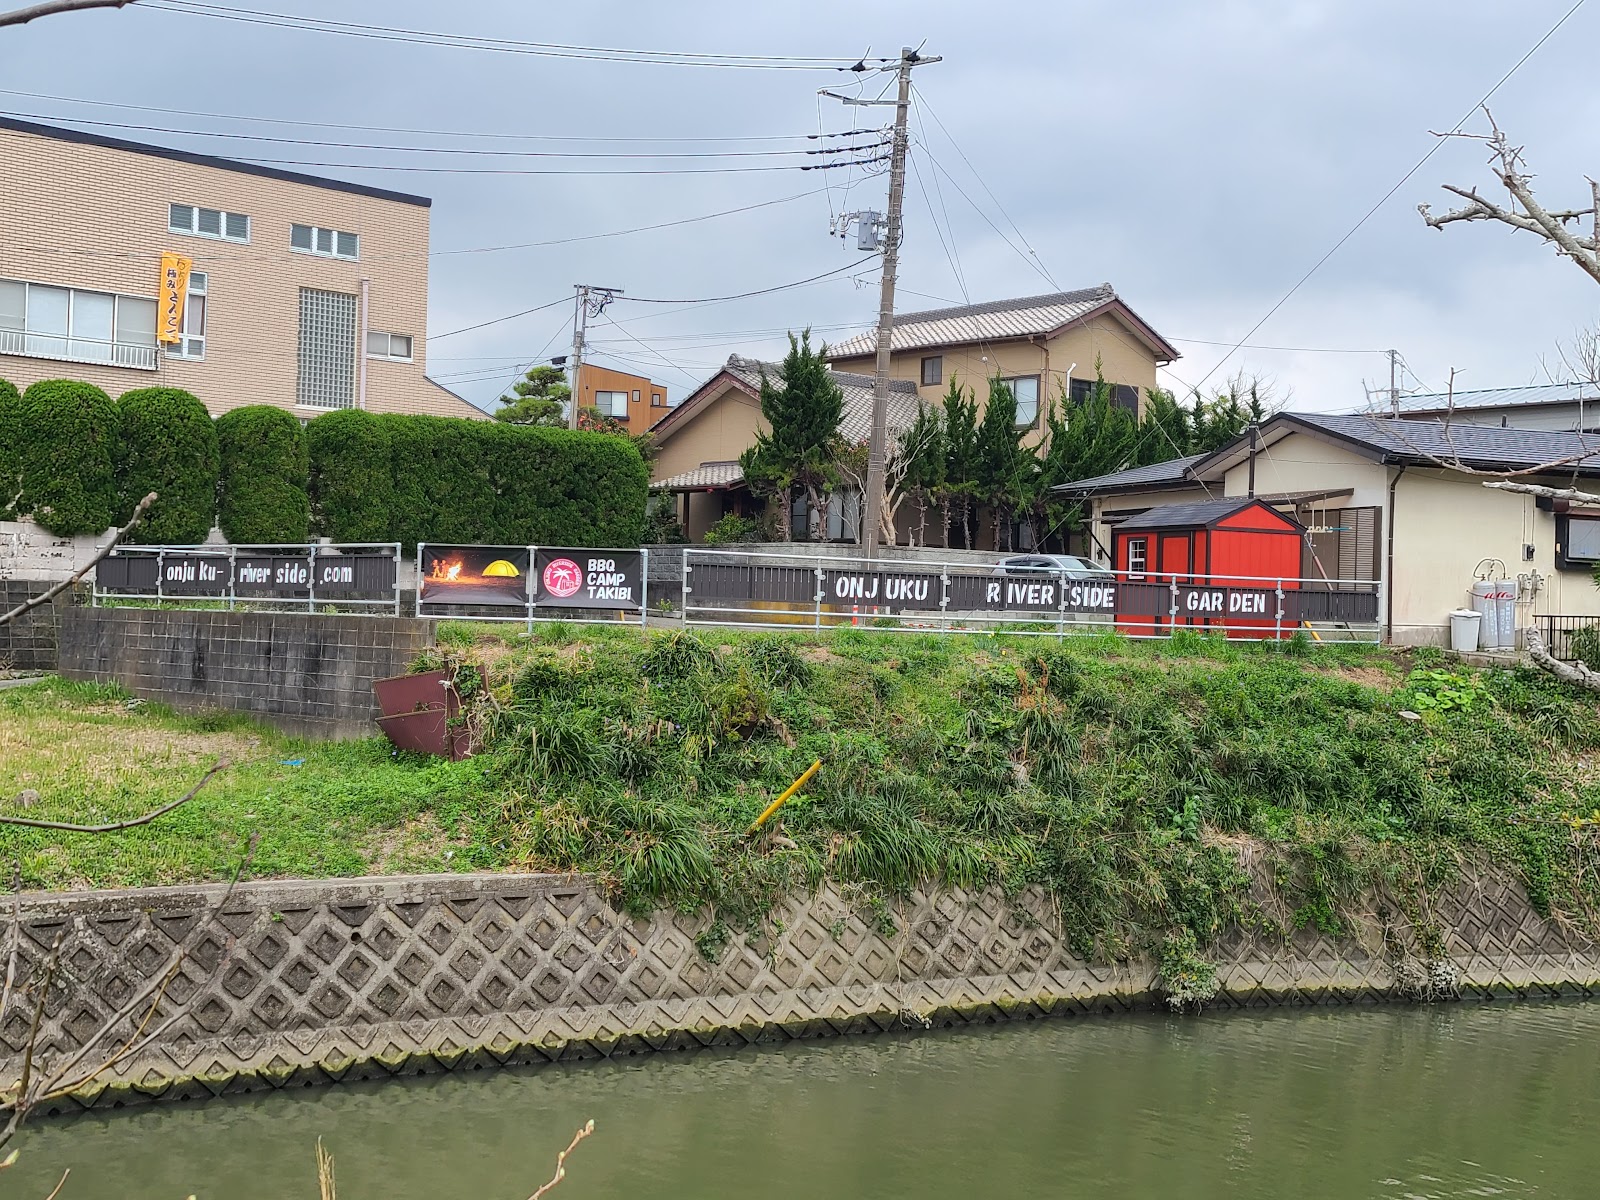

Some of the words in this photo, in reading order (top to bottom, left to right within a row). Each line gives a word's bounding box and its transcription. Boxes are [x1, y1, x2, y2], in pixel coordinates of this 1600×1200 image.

[587, 558, 616, 572] BBQ
[240, 562, 271, 584] river
[276, 562, 307, 584] side
[320, 566, 352, 585] .com
[586, 572, 626, 586] CAMP
[586, 586, 632, 601] TAKIBI
[1070, 586, 1115, 608] SIDE
